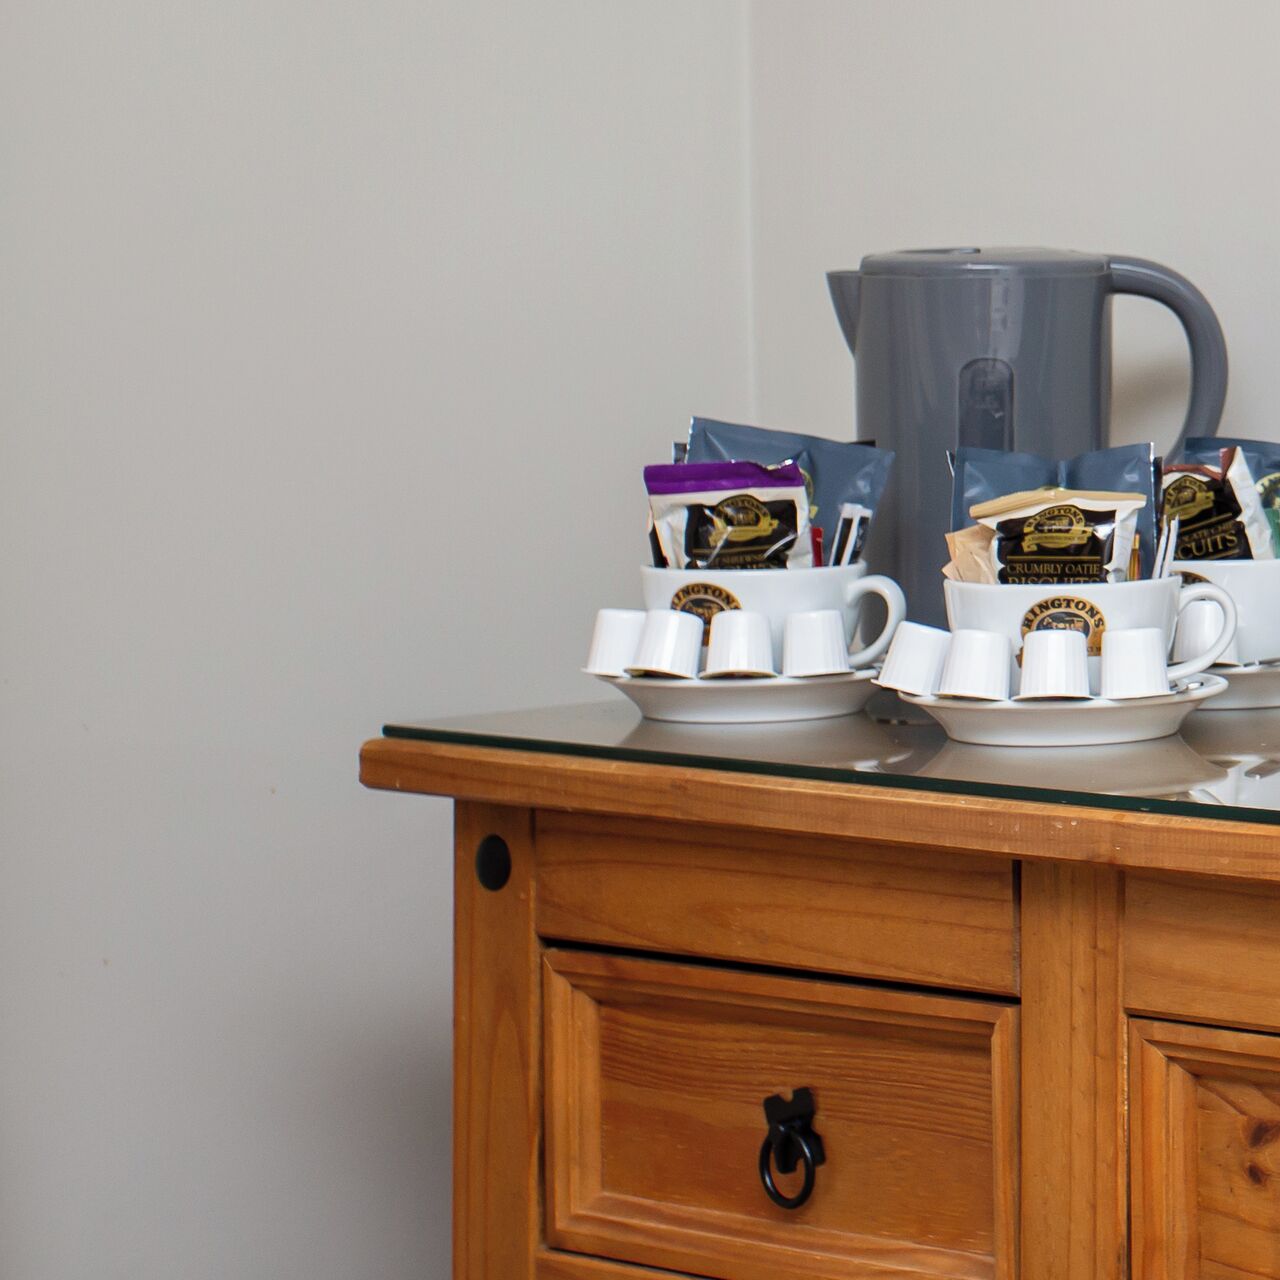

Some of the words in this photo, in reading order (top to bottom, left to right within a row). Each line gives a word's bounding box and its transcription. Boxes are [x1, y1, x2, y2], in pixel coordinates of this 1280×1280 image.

[1026, 507, 1083, 528] RINGTONS
[1178, 530, 1238, 560] CUITS
[1006, 562, 1063, 575] CRUMBLY
[1065, 563, 1100, 575] OATIE
[1022, 598, 1104, 629] RINGTONS
